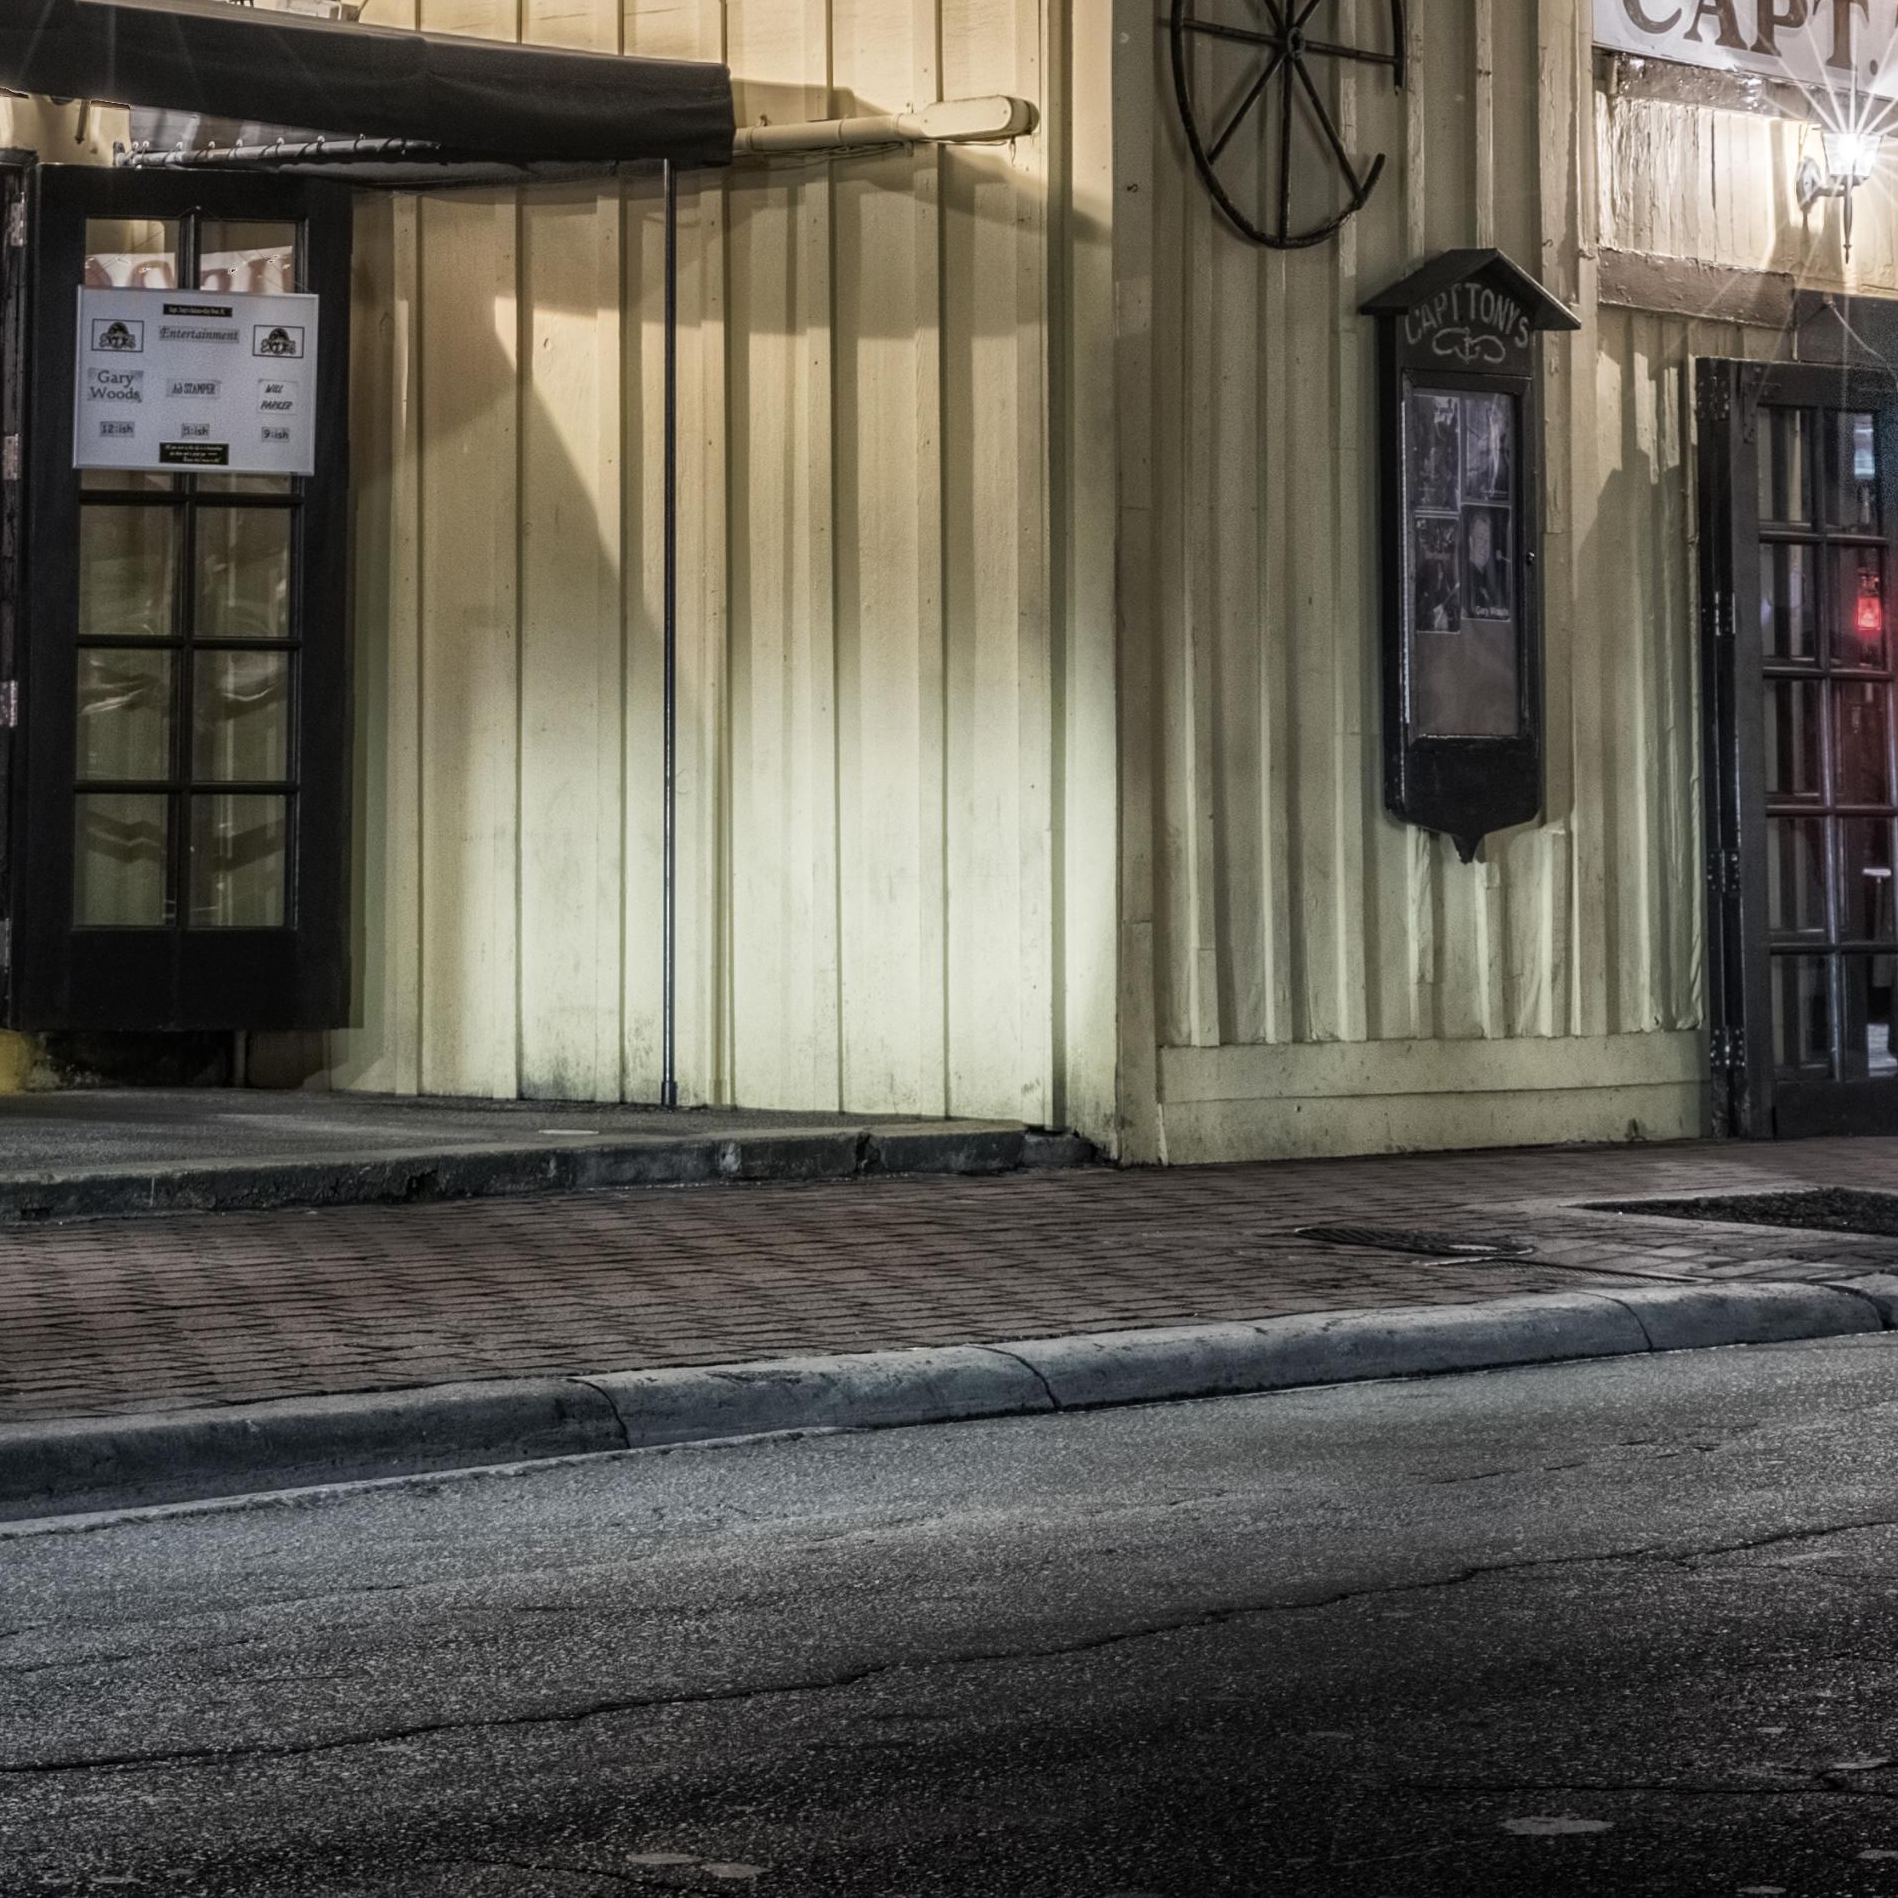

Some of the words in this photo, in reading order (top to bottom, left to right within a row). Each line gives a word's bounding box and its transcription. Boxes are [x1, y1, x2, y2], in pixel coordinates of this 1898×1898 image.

[159, 326, 239, 341] Entertainment
[97, 370, 135, 388] Gary
[90, 386, 141, 401] Woods
[101, 423, 135, 434] 12:ish
[182, 426, 209, 437] 5:ish
[263, 429, 290, 440] 9:ish
